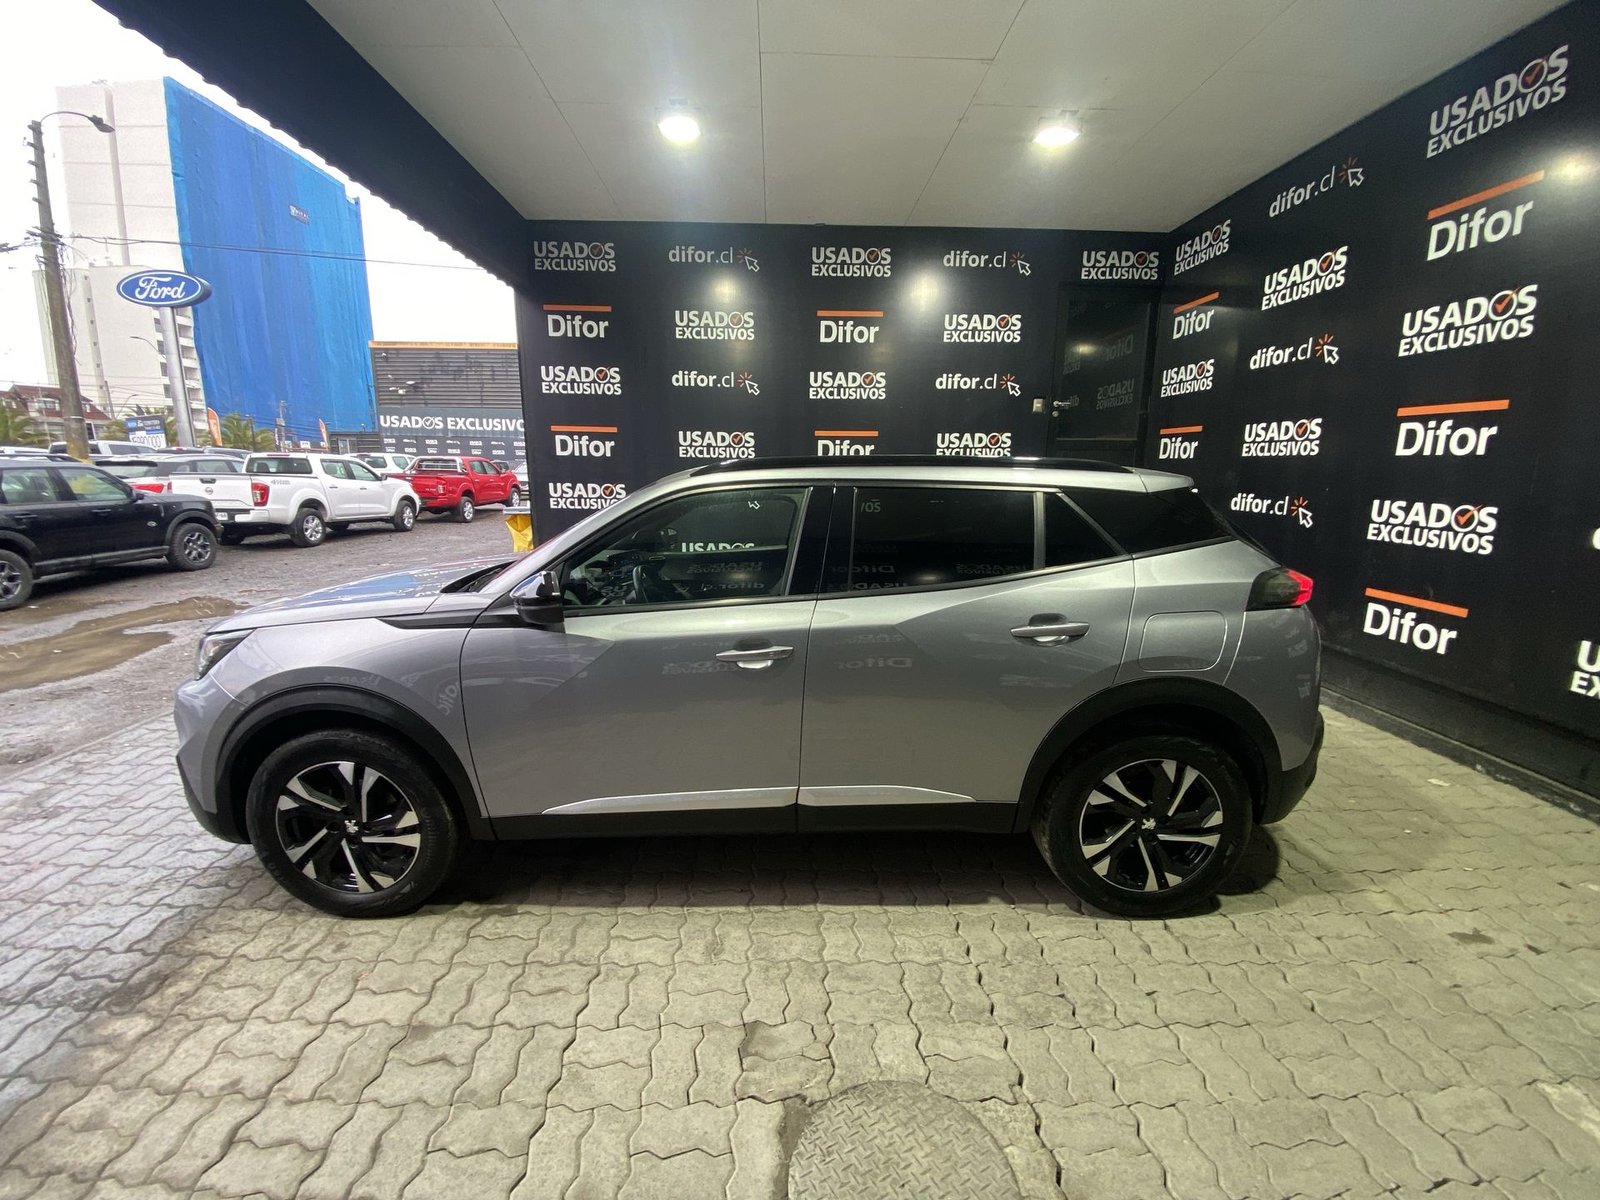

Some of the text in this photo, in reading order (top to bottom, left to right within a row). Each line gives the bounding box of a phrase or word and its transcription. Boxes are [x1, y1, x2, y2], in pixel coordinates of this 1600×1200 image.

[1429, 45, 1569, 136] USADOS
[1426, 77, 1566, 158] EXCLUSIVOS
[1269, 165, 1336, 218] difor.cl
[1426, 200, 1534, 261] Difor
[1176, 219, 1231, 262] USADOS
[533, 241, 615, 260] USADOS
[668, 246, 733, 263] difor.cl
[811, 247, 891, 264] USADOS
[943, 250, 1006, 268] difor.cl
[1082, 250, 1159, 268] USADOS
[1174, 238, 1229, 276] EXCLUSIVOS
[534, 257, 617, 272] EXCLUSIVOS
[811, 263, 891, 277] EXCLUSIVOS
[1081, 267, 1158, 280] EXCLUSIVOS
[1263, 246, 1348, 295] USADOS
[135, 276, 185, 299] Ford
[1261, 269, 1346, 311] EXCLUSIVOS
[674, 310, 755, 328] USADOS
[1402, 284, 1538, 336] USADOS
[547, 314, 609, 338] Difor
[819, 320, 880, 343] Difor
[944, 314, 1022, 331] USADOS
[1172, 308, 1215, 340] Difor
[675, 327, 755, 341] EXCLUSIVOS
[943, 330, 1021, 343] EXCLUSIVOS
[1398, 315, 1534, 357] EXCLUSIVOS
[1250, 337, 1313, 370] difor.cl
[541, 365, 620, 384] USADOS
[672, 371, 734, 388] difor.cl
[809, 371, 886, 389] USADOS
[935, 373, 997, 390] difor.cl
[1162, 359, 1215, 386] USADOS
[542, 381, 622, 395] EXCLUSIVOS
[809, 388, 886, 400] EXCLUSIVOS
[1160, 377, 1213, 398] EXCLUSIVOS
[380, 415, 444, 430] USADOS
[1244, 418, 1322, 443] USADOS
[555, 435, 615, 457] Difor
[678, 431, 755, 448] USADOS
[817, 439, 875, 457] Difor
[936, 432, 1012, 449] USADOS
[1395, 421, 1498, 456] Difor
[679, 446, 755, 459] EXCLUSIVOS
[1159, 437, 1198, 460] Difor
[1241, 440, 1320, 457] EXCLUSIVOS
[548, 482, 627, 499] USADOS
[550, 498, 620, 510] EXCLUSIV
[1230, 493, 1289, 516] difor.cl
[1370, 499, 1498, 533] USADOS
[1366, 524, 1495, 555] EXCLUSIVOS
[1363, 602, 1457, 655] Difor
